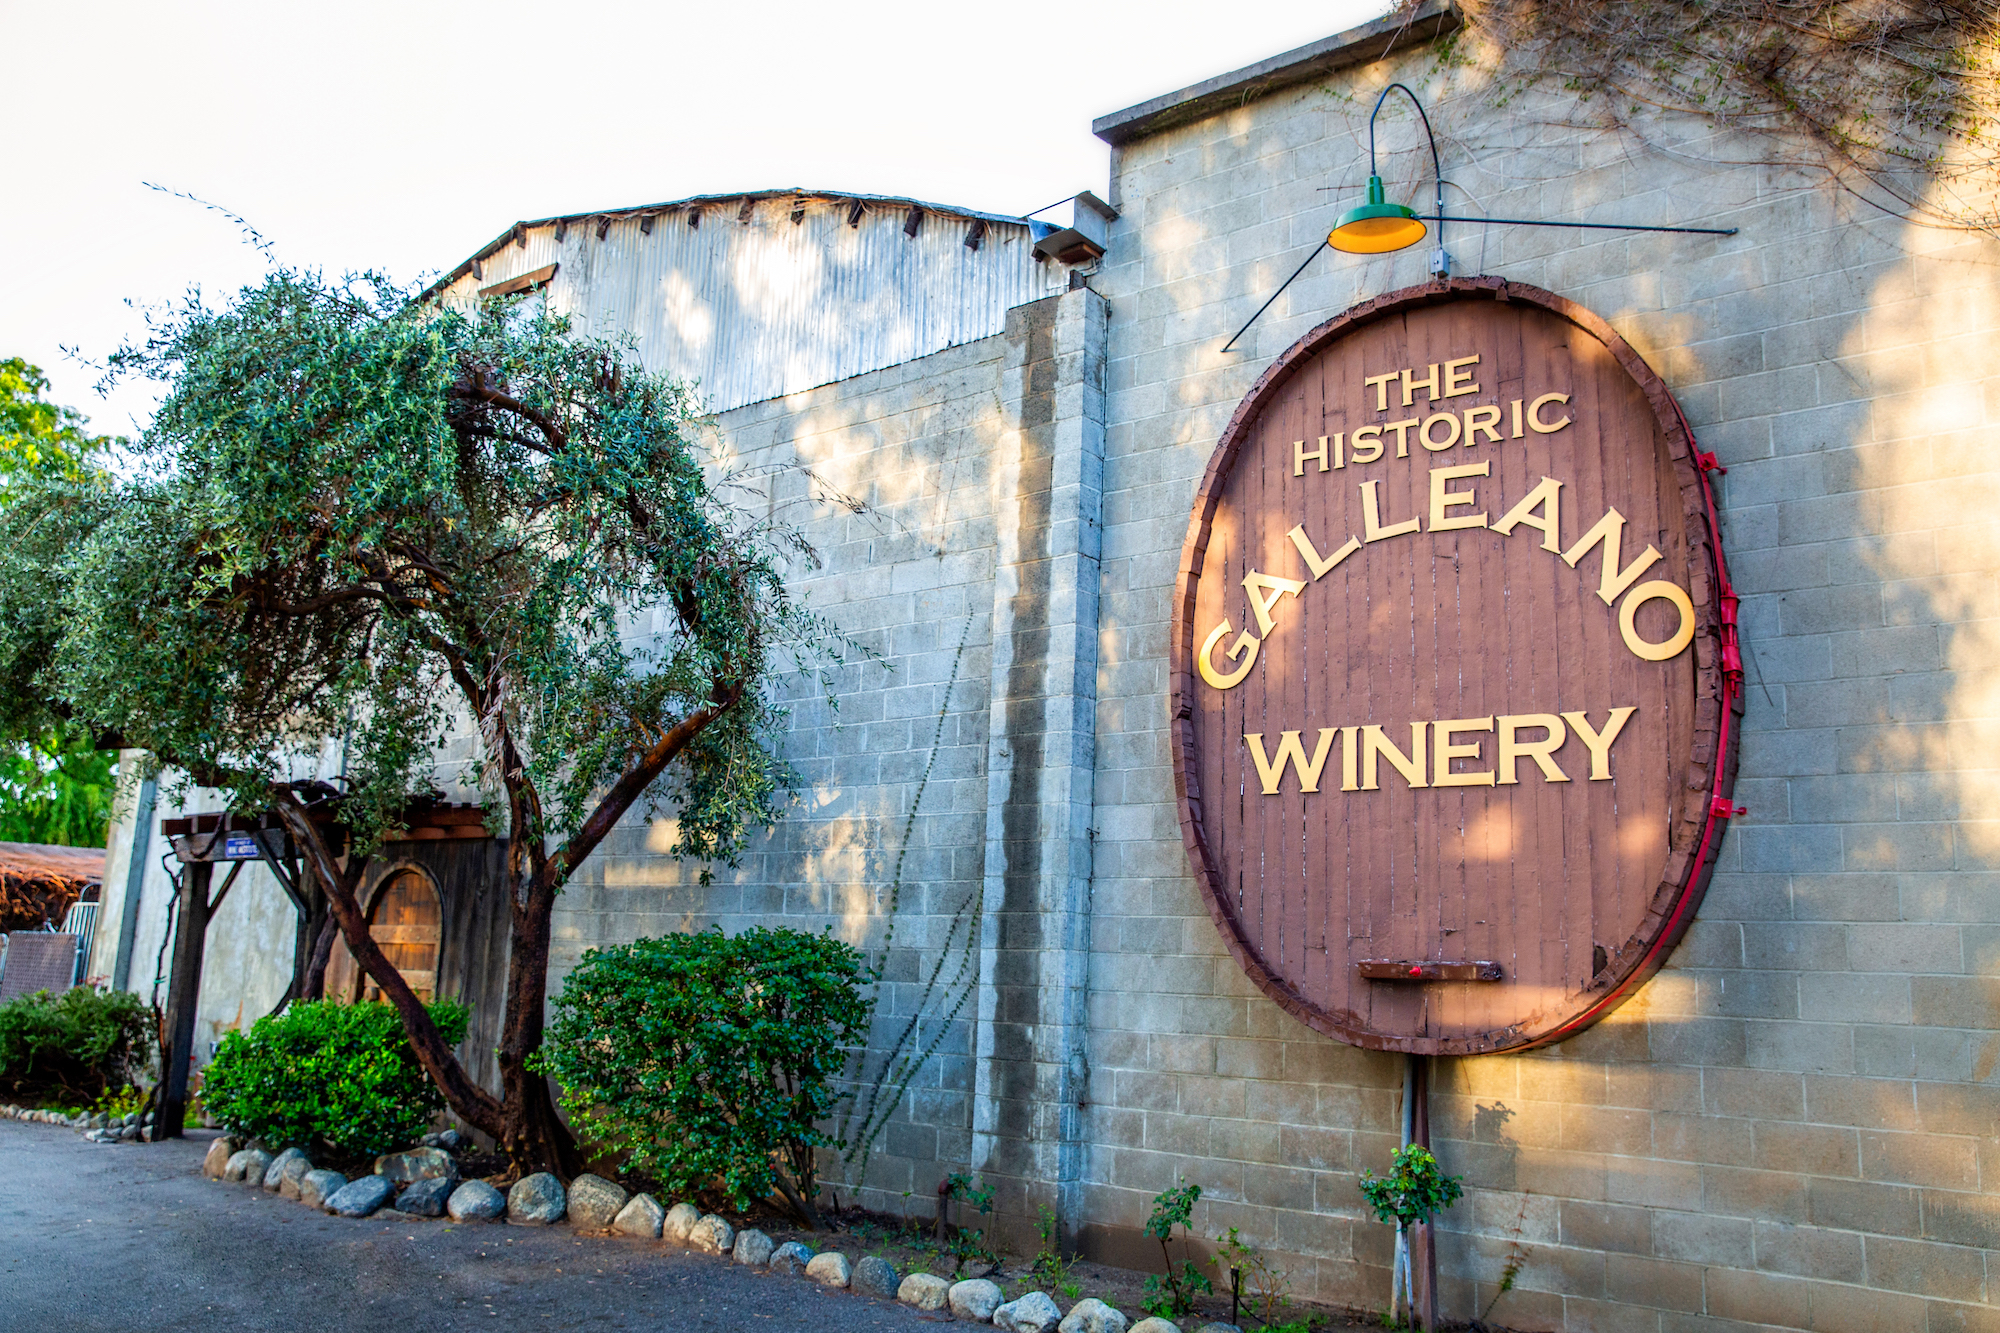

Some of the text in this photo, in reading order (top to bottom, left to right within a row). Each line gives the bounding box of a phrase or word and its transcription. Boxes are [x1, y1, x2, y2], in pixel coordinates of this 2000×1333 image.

[1366, 354, 1480, 411] THE
[1293, 392, 1571, 476] HISTORIC
[1198, 459, 1696, 690] GALLEANO
[1243, 706, 1637, 795] WINERY
